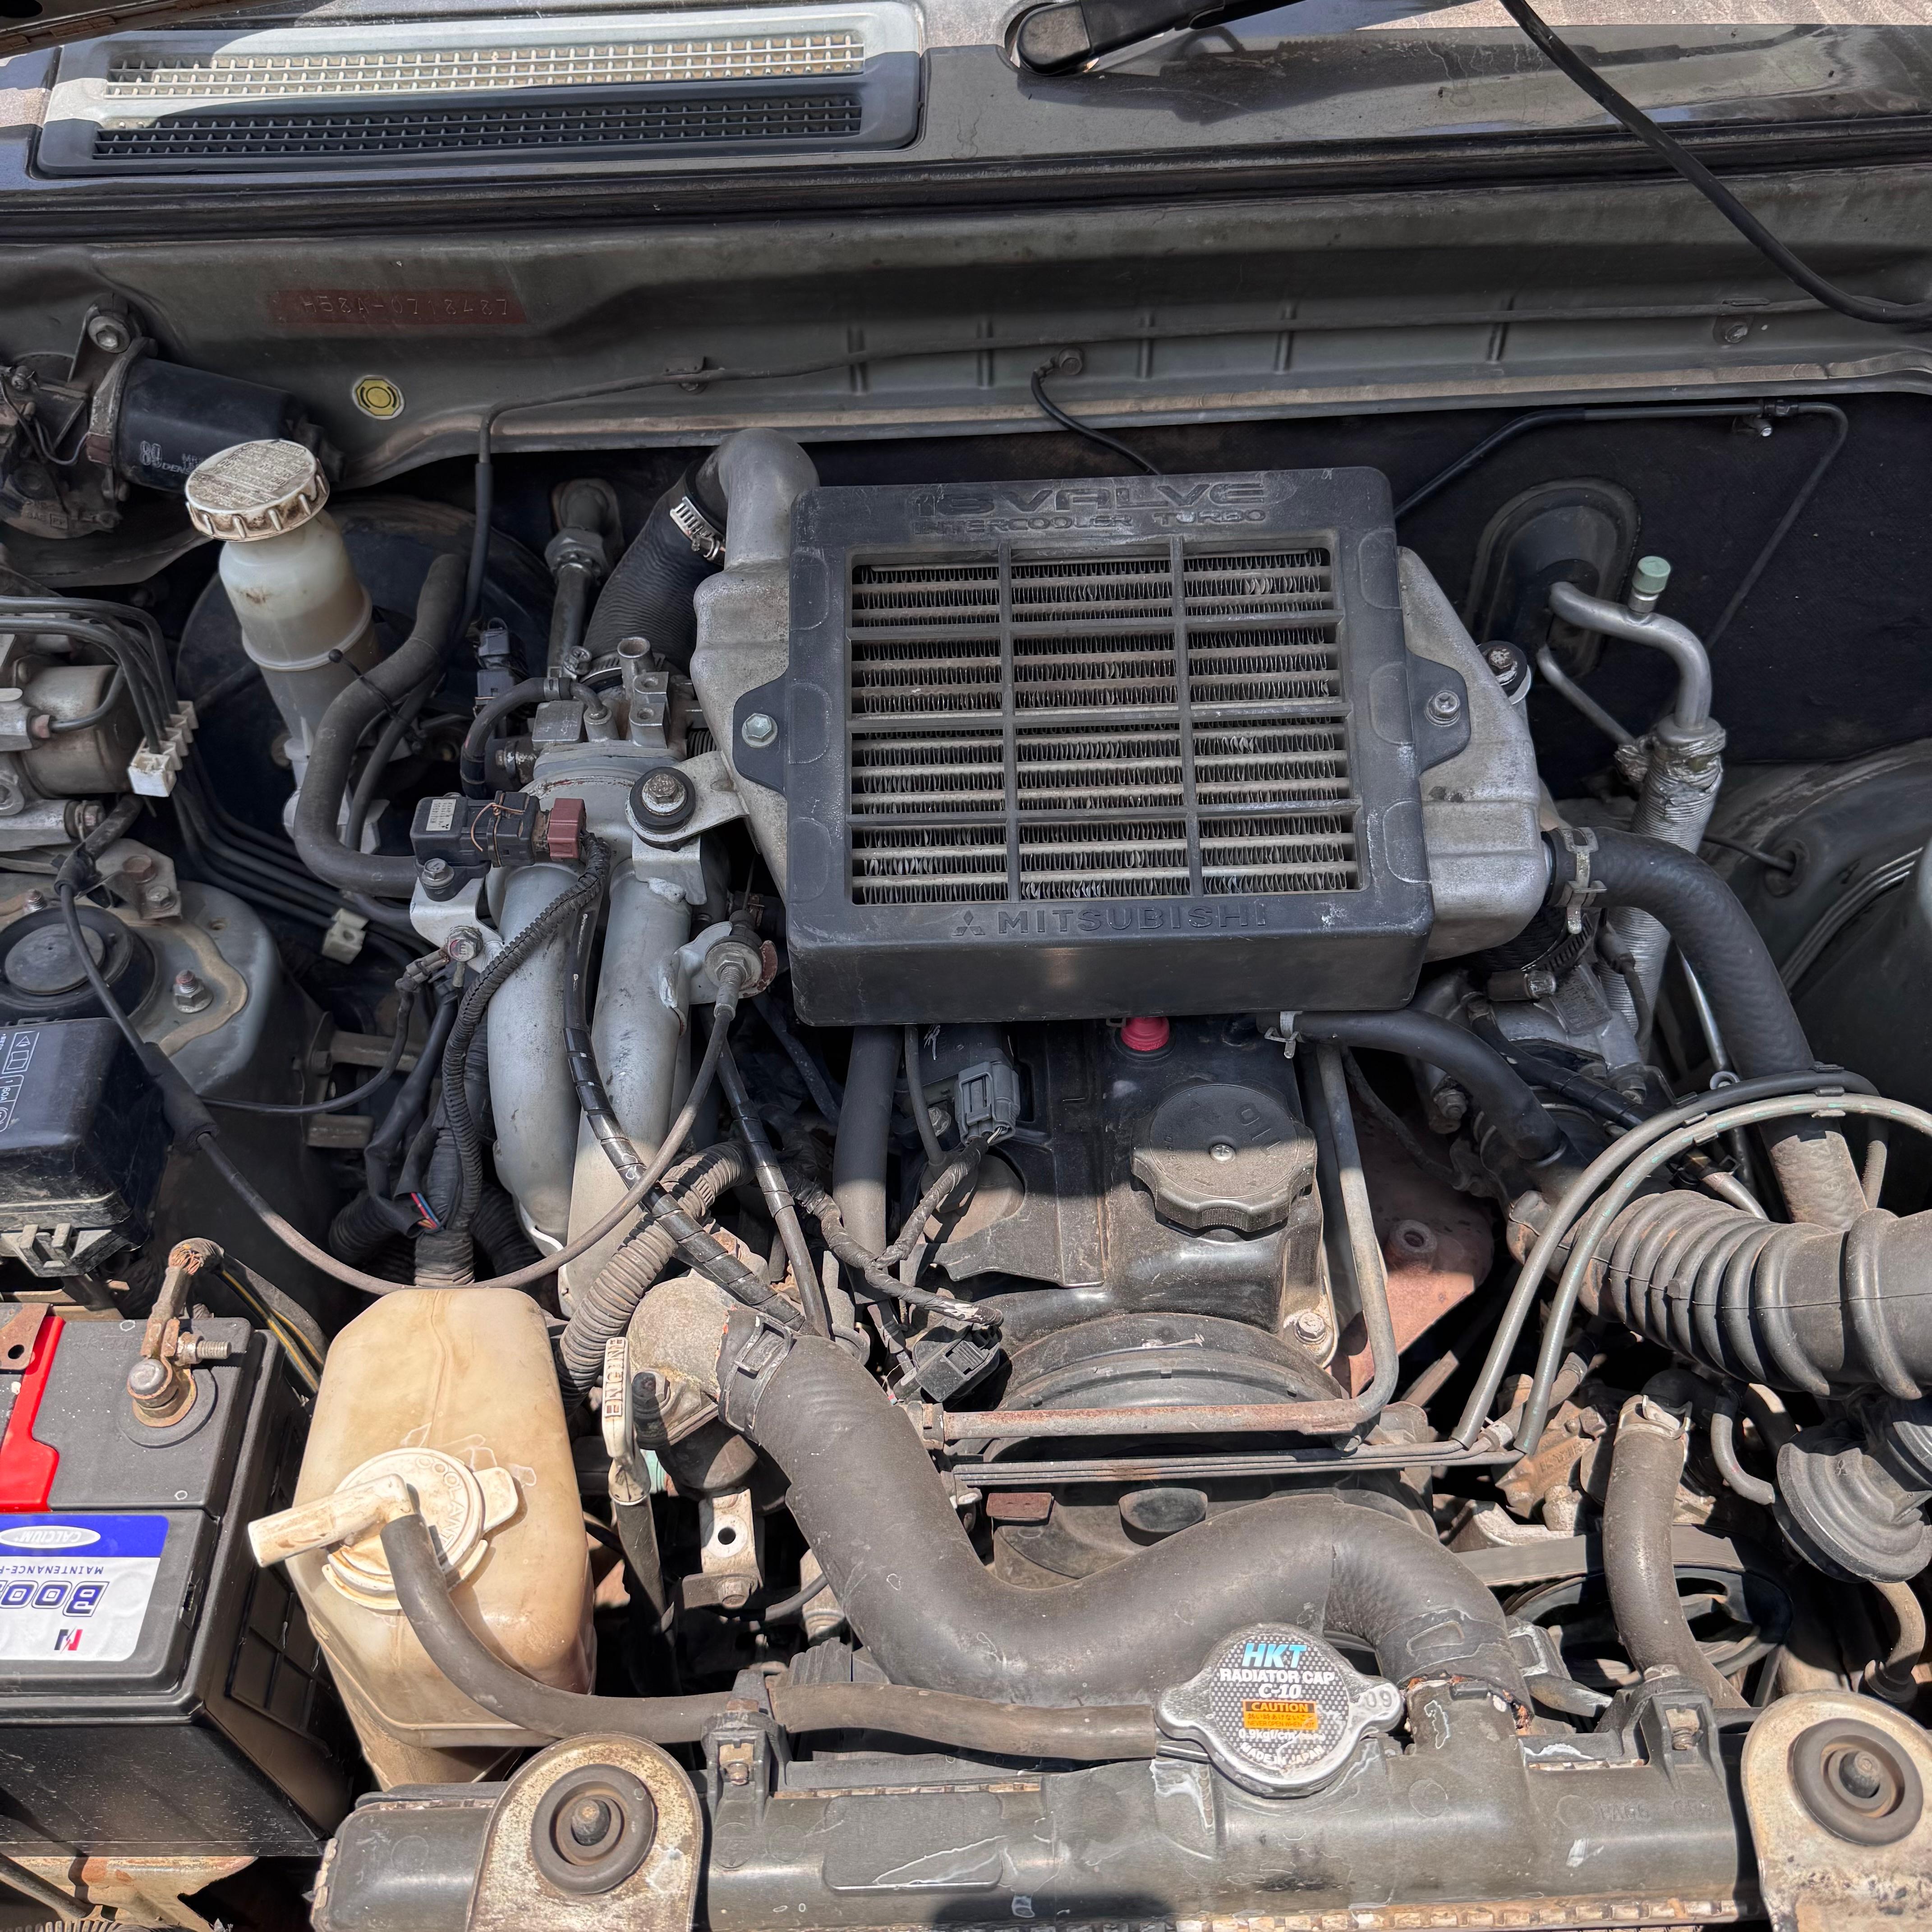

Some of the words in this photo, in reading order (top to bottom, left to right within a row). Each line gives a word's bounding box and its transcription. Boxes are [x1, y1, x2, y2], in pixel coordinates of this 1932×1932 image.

[913, 514, 1133, 534] INTERCOOLER
[1153, 509, 1266, 526] TURBO
[998, 904, 1266, 934] MITSUBISHI
[1236, 1103, 1282, 1155] OIL
[605, 1338, 625, 1417] ENGINE
[416, 1455, 466, 1550] COOLANT
[0, 1580, 110, 1617] BOO
[1242, 1642, 1307, 1668] HKT
[1219, 1668, 1301, 1684] RADIATOR
[1302, 1671, 1335, 1685] CAP
[1258, 1683, 1302, 1698] C-10
[1251, 1702, 1309, 1712] CAUTION
[1240, 1742, 1271, 1764] MADE
[1288, 1744, 1325, 1765] JAPAN
